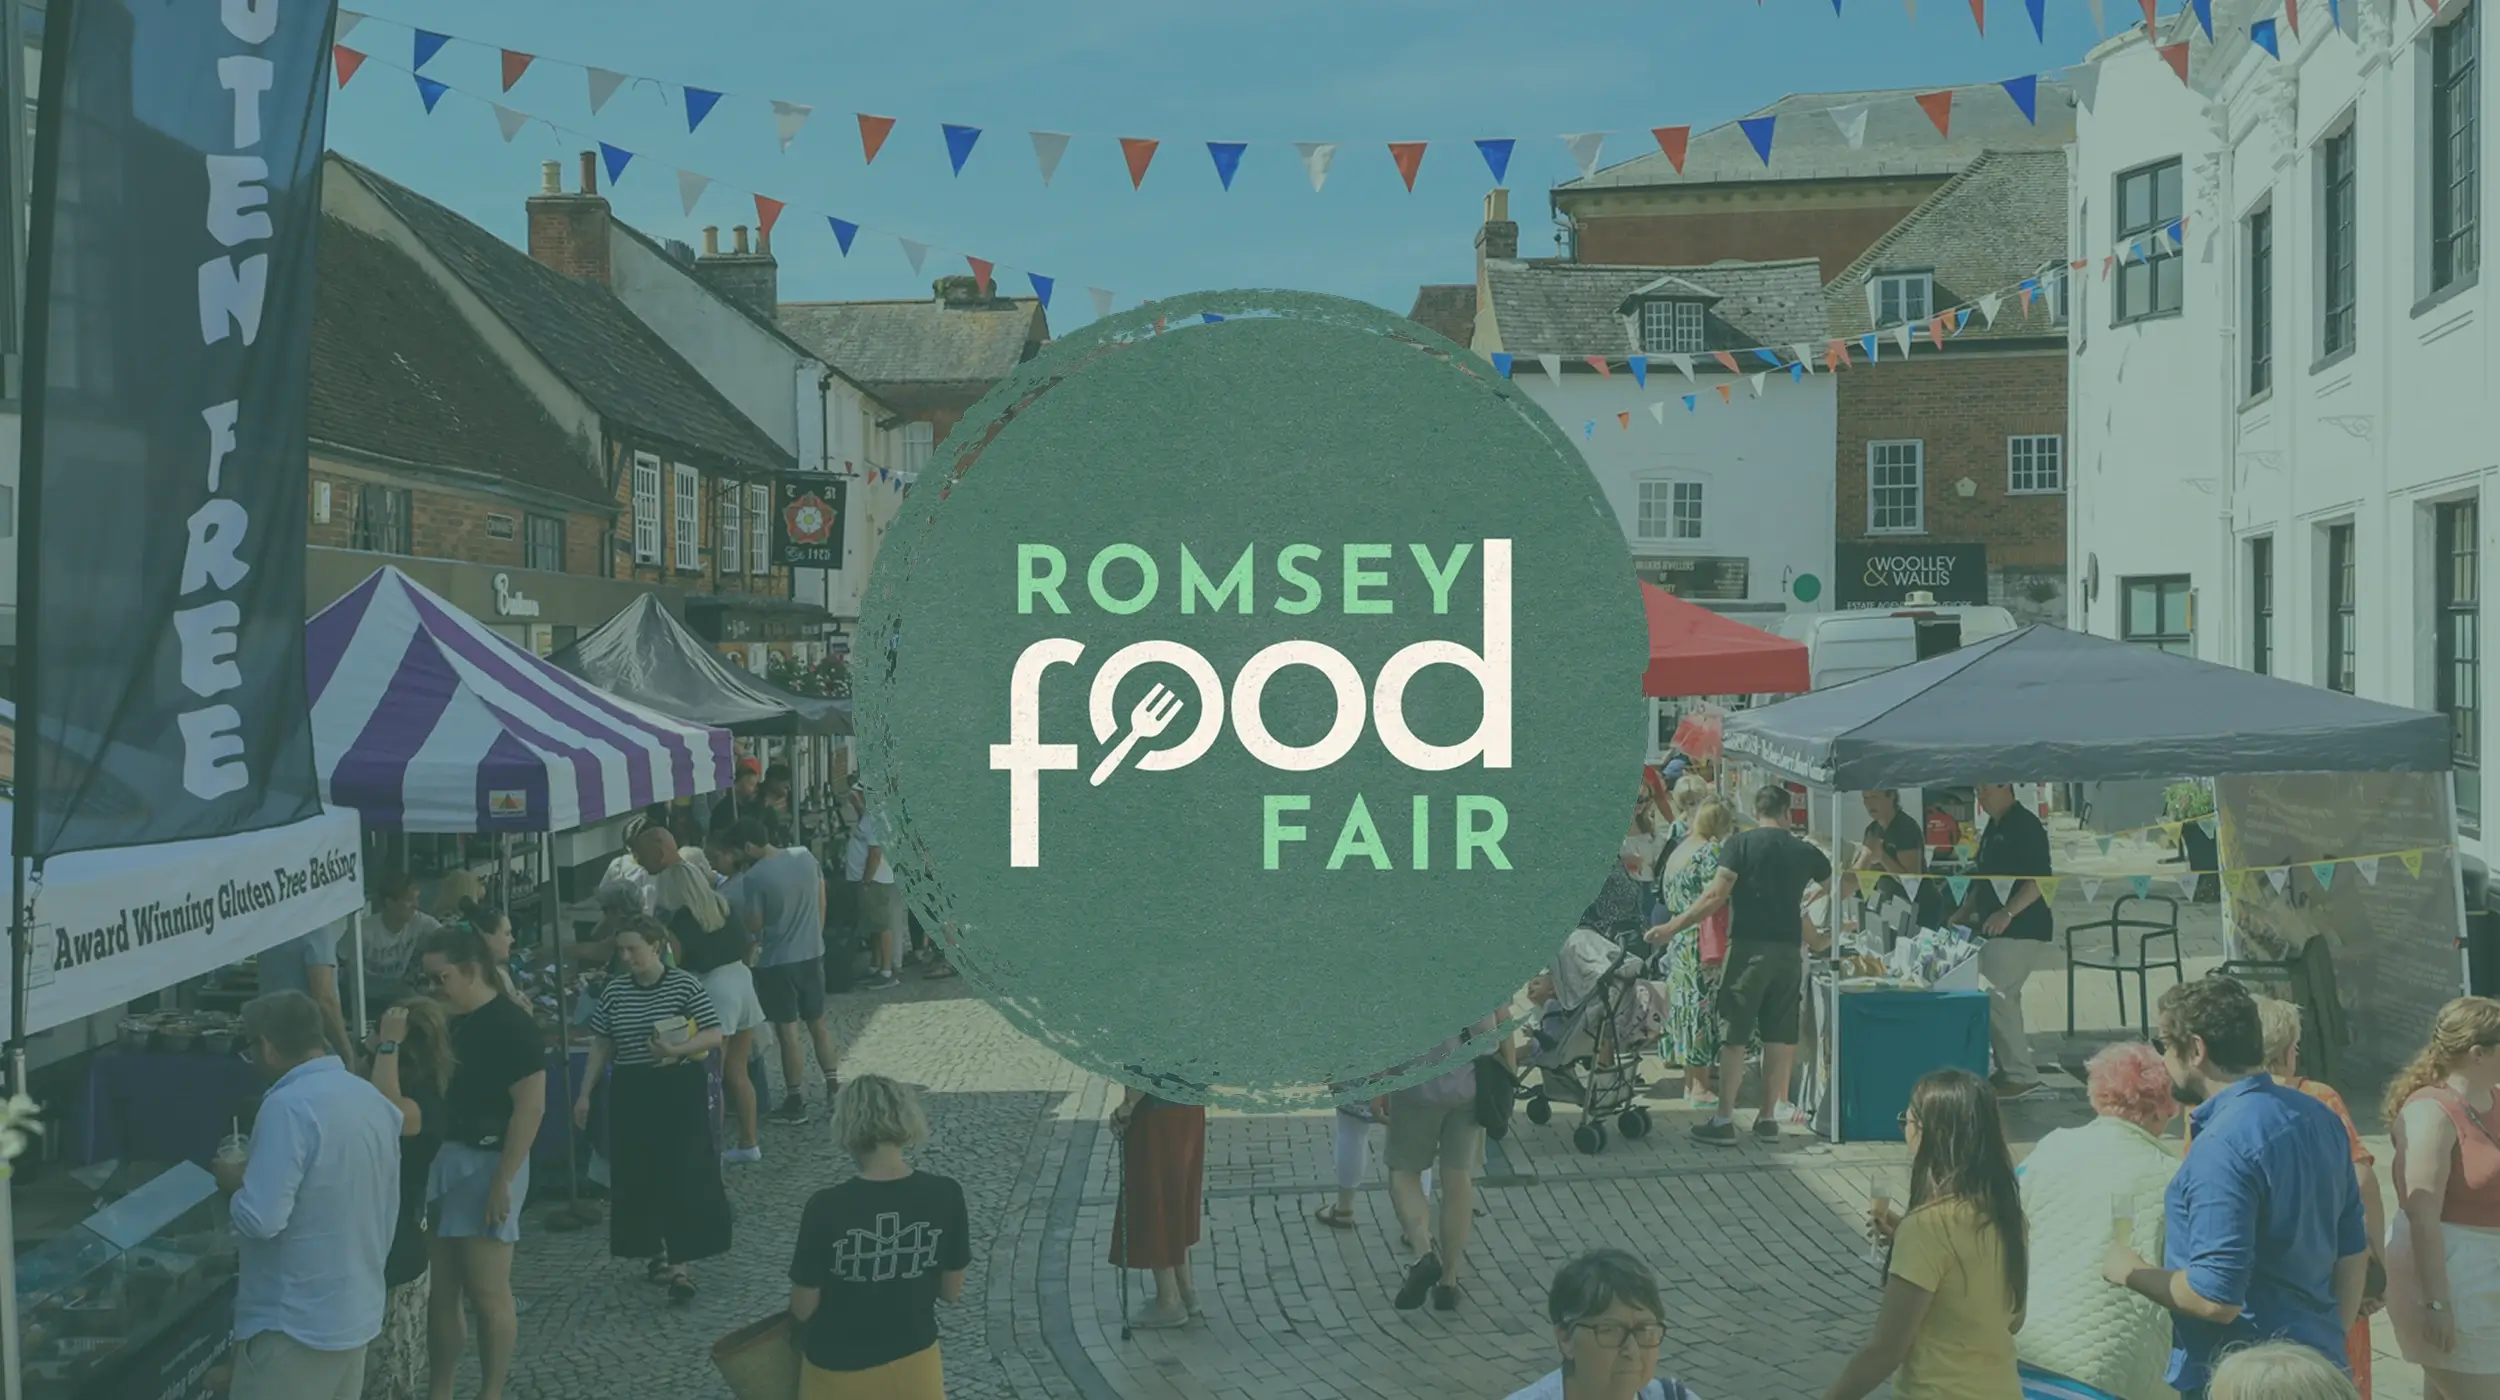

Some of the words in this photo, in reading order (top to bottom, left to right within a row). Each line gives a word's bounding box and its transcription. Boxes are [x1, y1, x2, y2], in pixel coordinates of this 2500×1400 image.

[172, 399, 252, 801] FREE
[1863, 557, 1888, 587] &
[1892, 571, 1950, 586] WALLIS
[1875, 556, 1956, 571] WOOLLEY
[54, 908, 130, 972] Award
[132, 891, 214, 947] Winning
[218, 879, 276, 920] Gluten
[274, 868, 307, 903] Free
[310, 848, 356, 890] Baking
